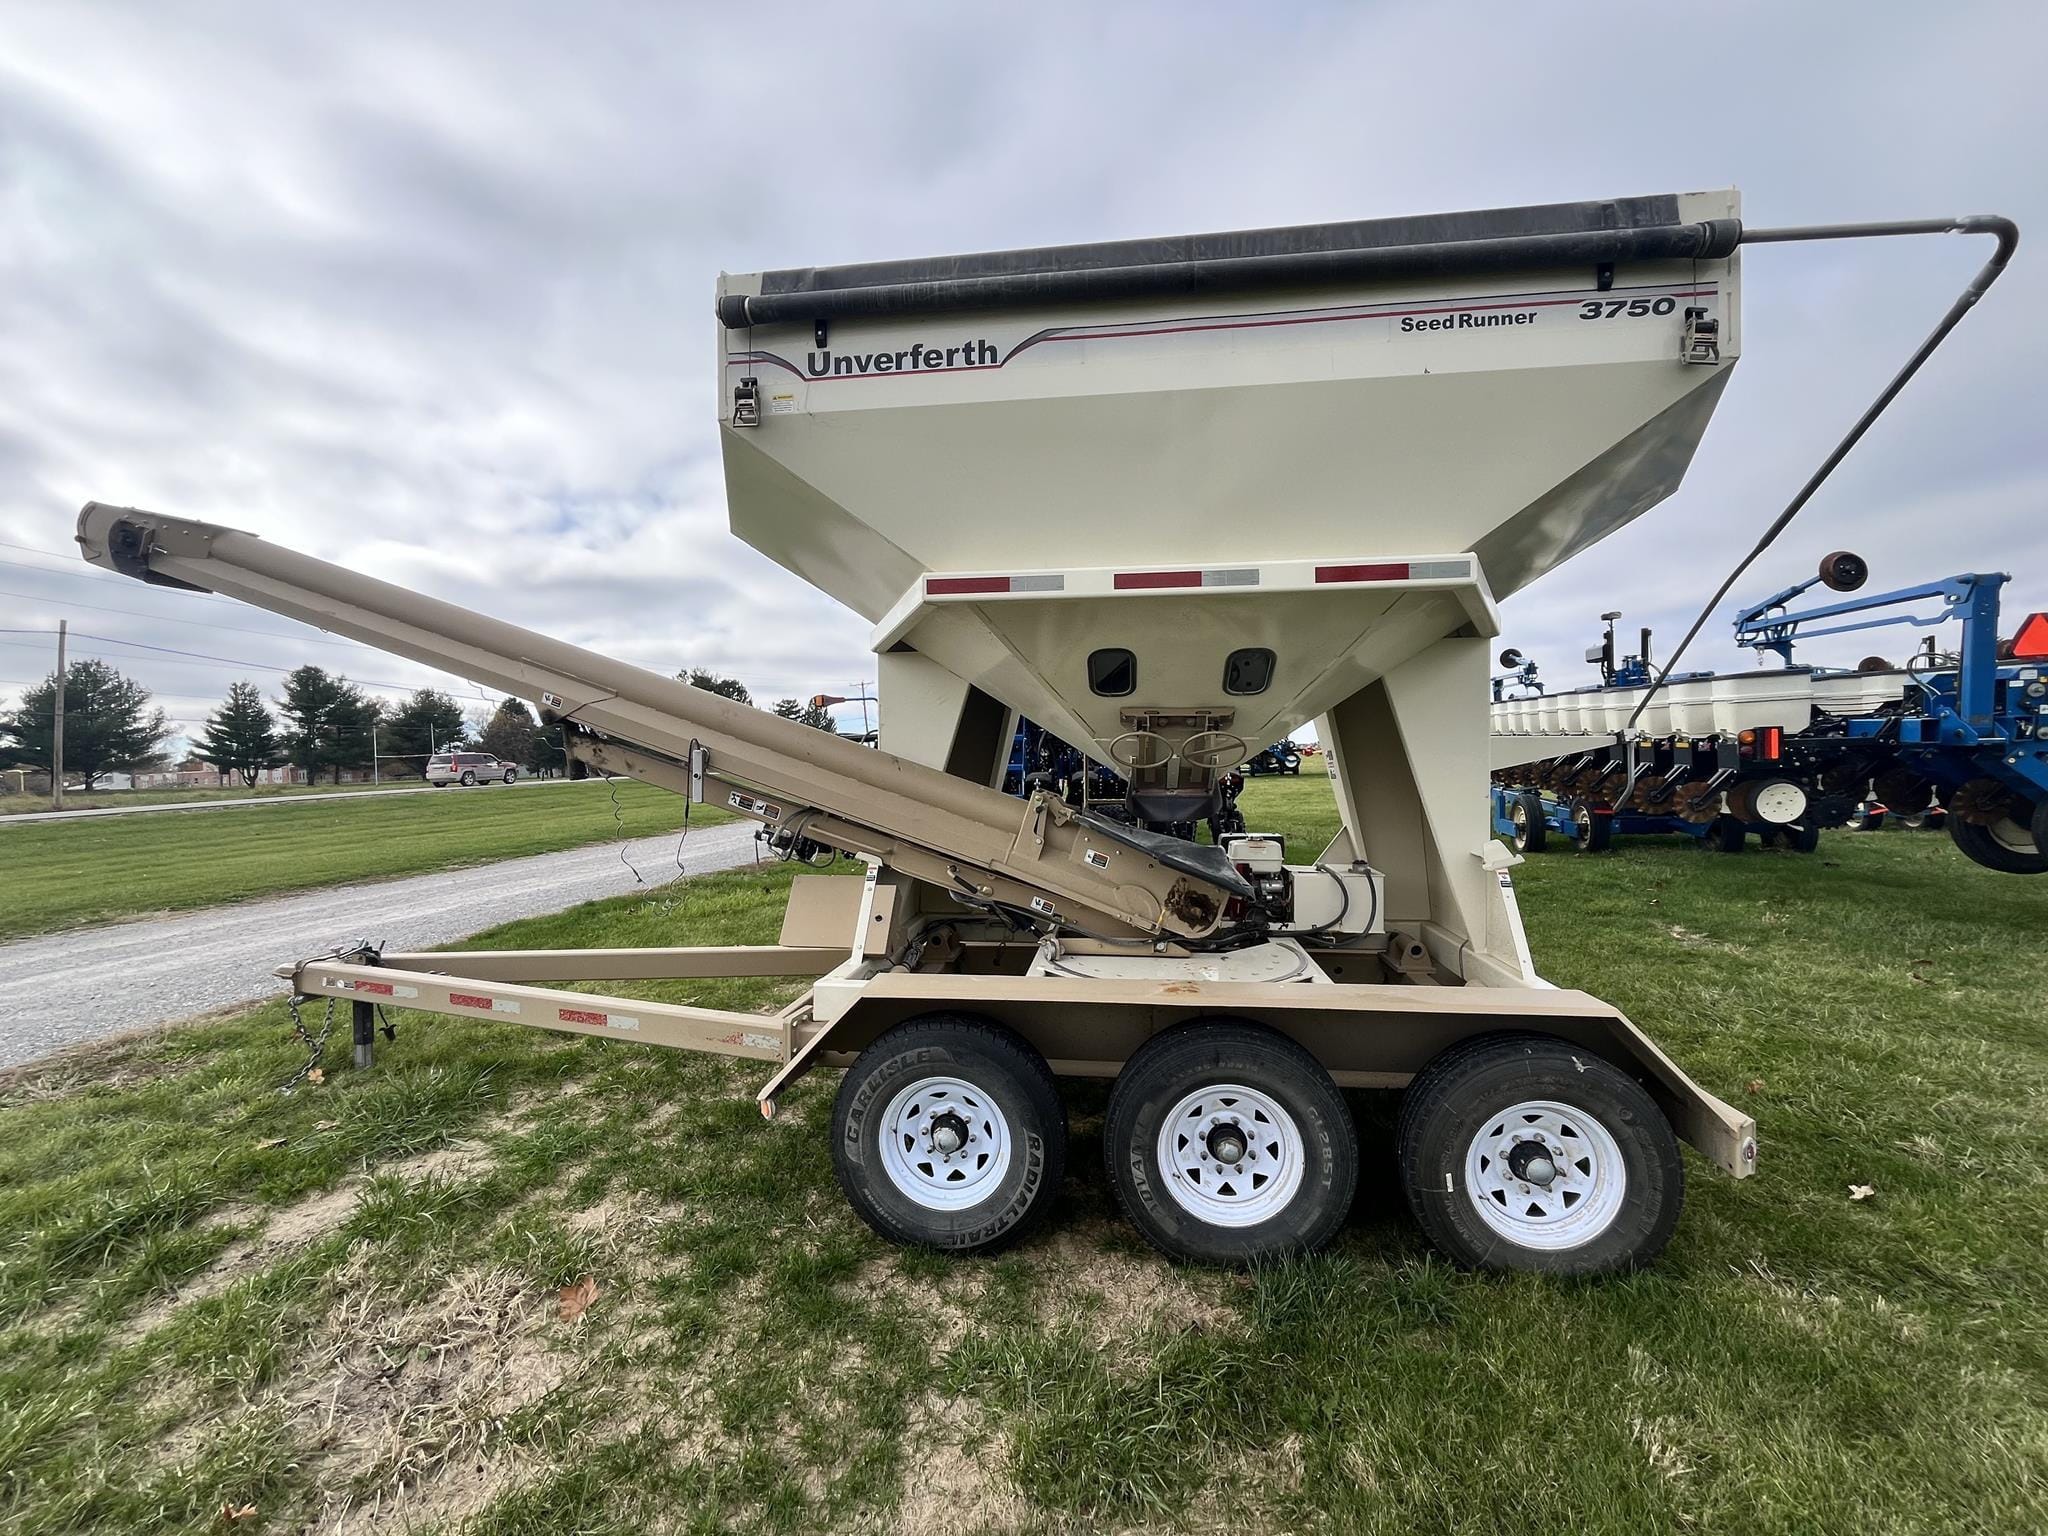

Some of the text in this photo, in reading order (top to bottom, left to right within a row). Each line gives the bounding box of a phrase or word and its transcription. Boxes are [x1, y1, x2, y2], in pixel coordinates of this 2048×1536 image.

[1401, 311, 1537, 333] Seed Runner
[1579, 297, 1675, 320] 3750
[807, 339, 998, 376] Unverferth
[847, 1049, 931, 1143] CARLISLE
